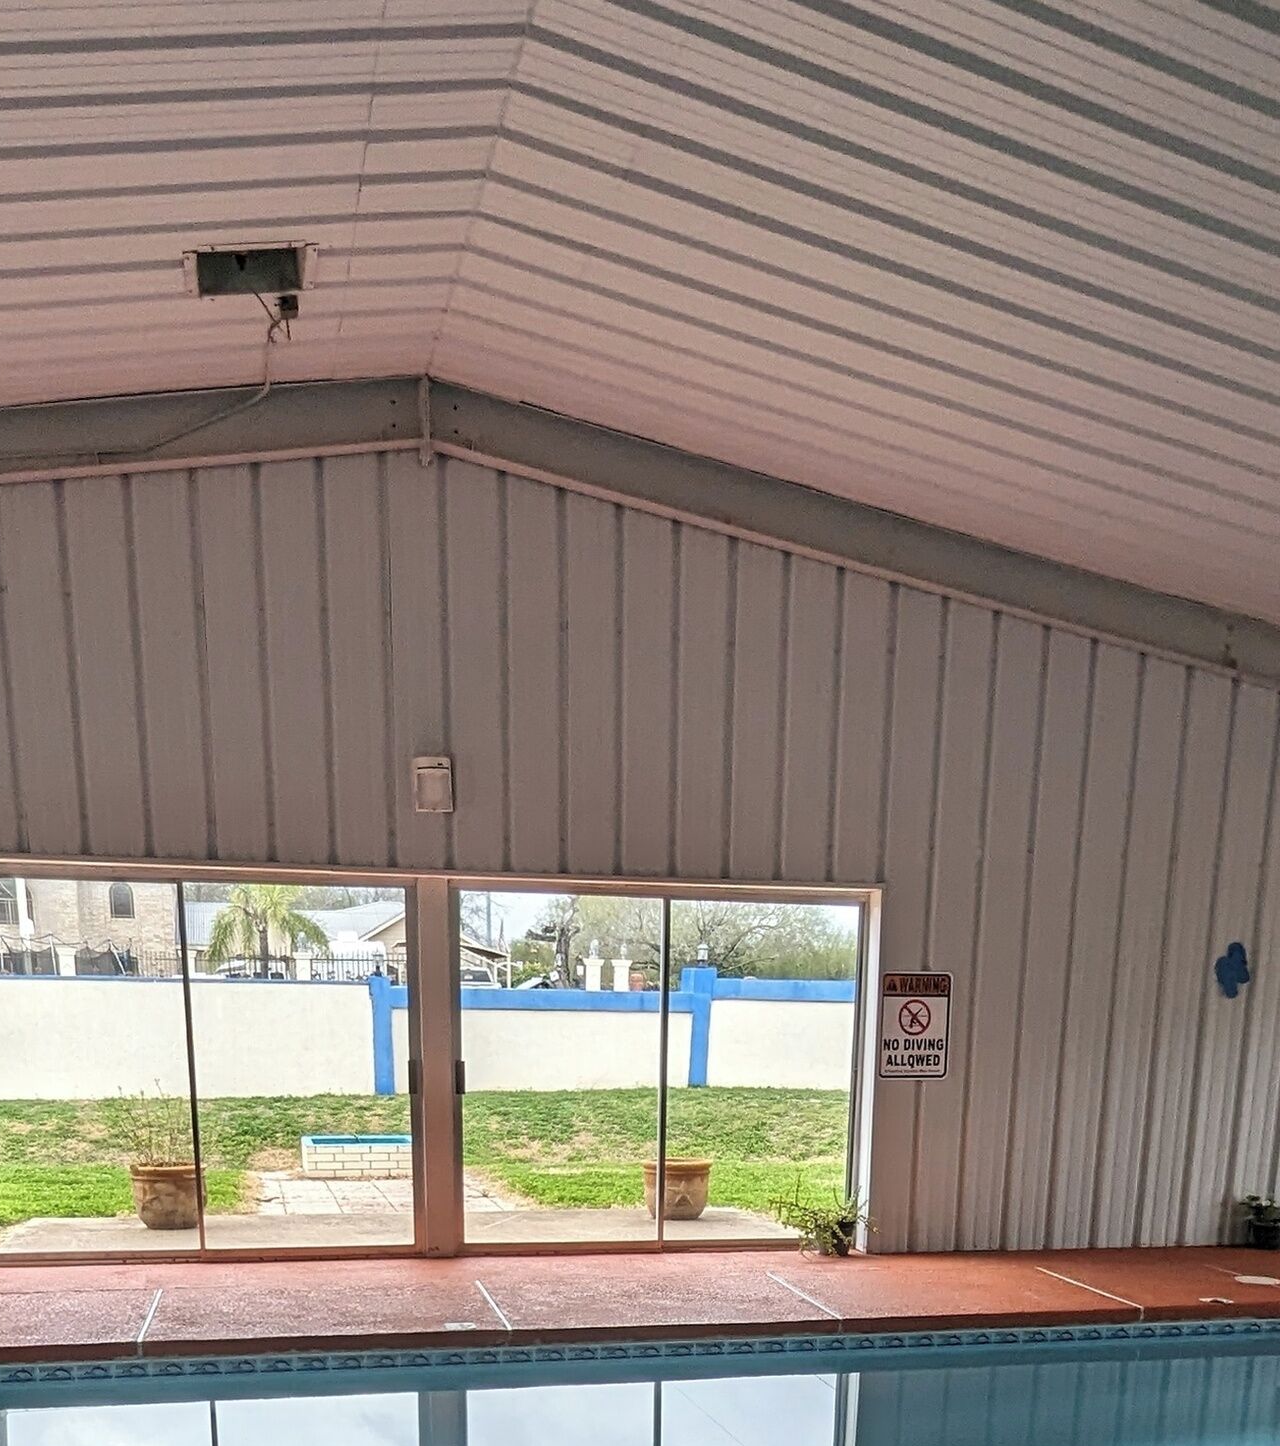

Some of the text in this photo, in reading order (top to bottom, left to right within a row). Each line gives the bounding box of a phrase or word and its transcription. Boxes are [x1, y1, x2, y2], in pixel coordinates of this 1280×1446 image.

[899, 977, 949, 993] WARNING
[883, 1038, 944, 1051] NO DIVING
[886, 1054, 941, 1067] ALLOWED
